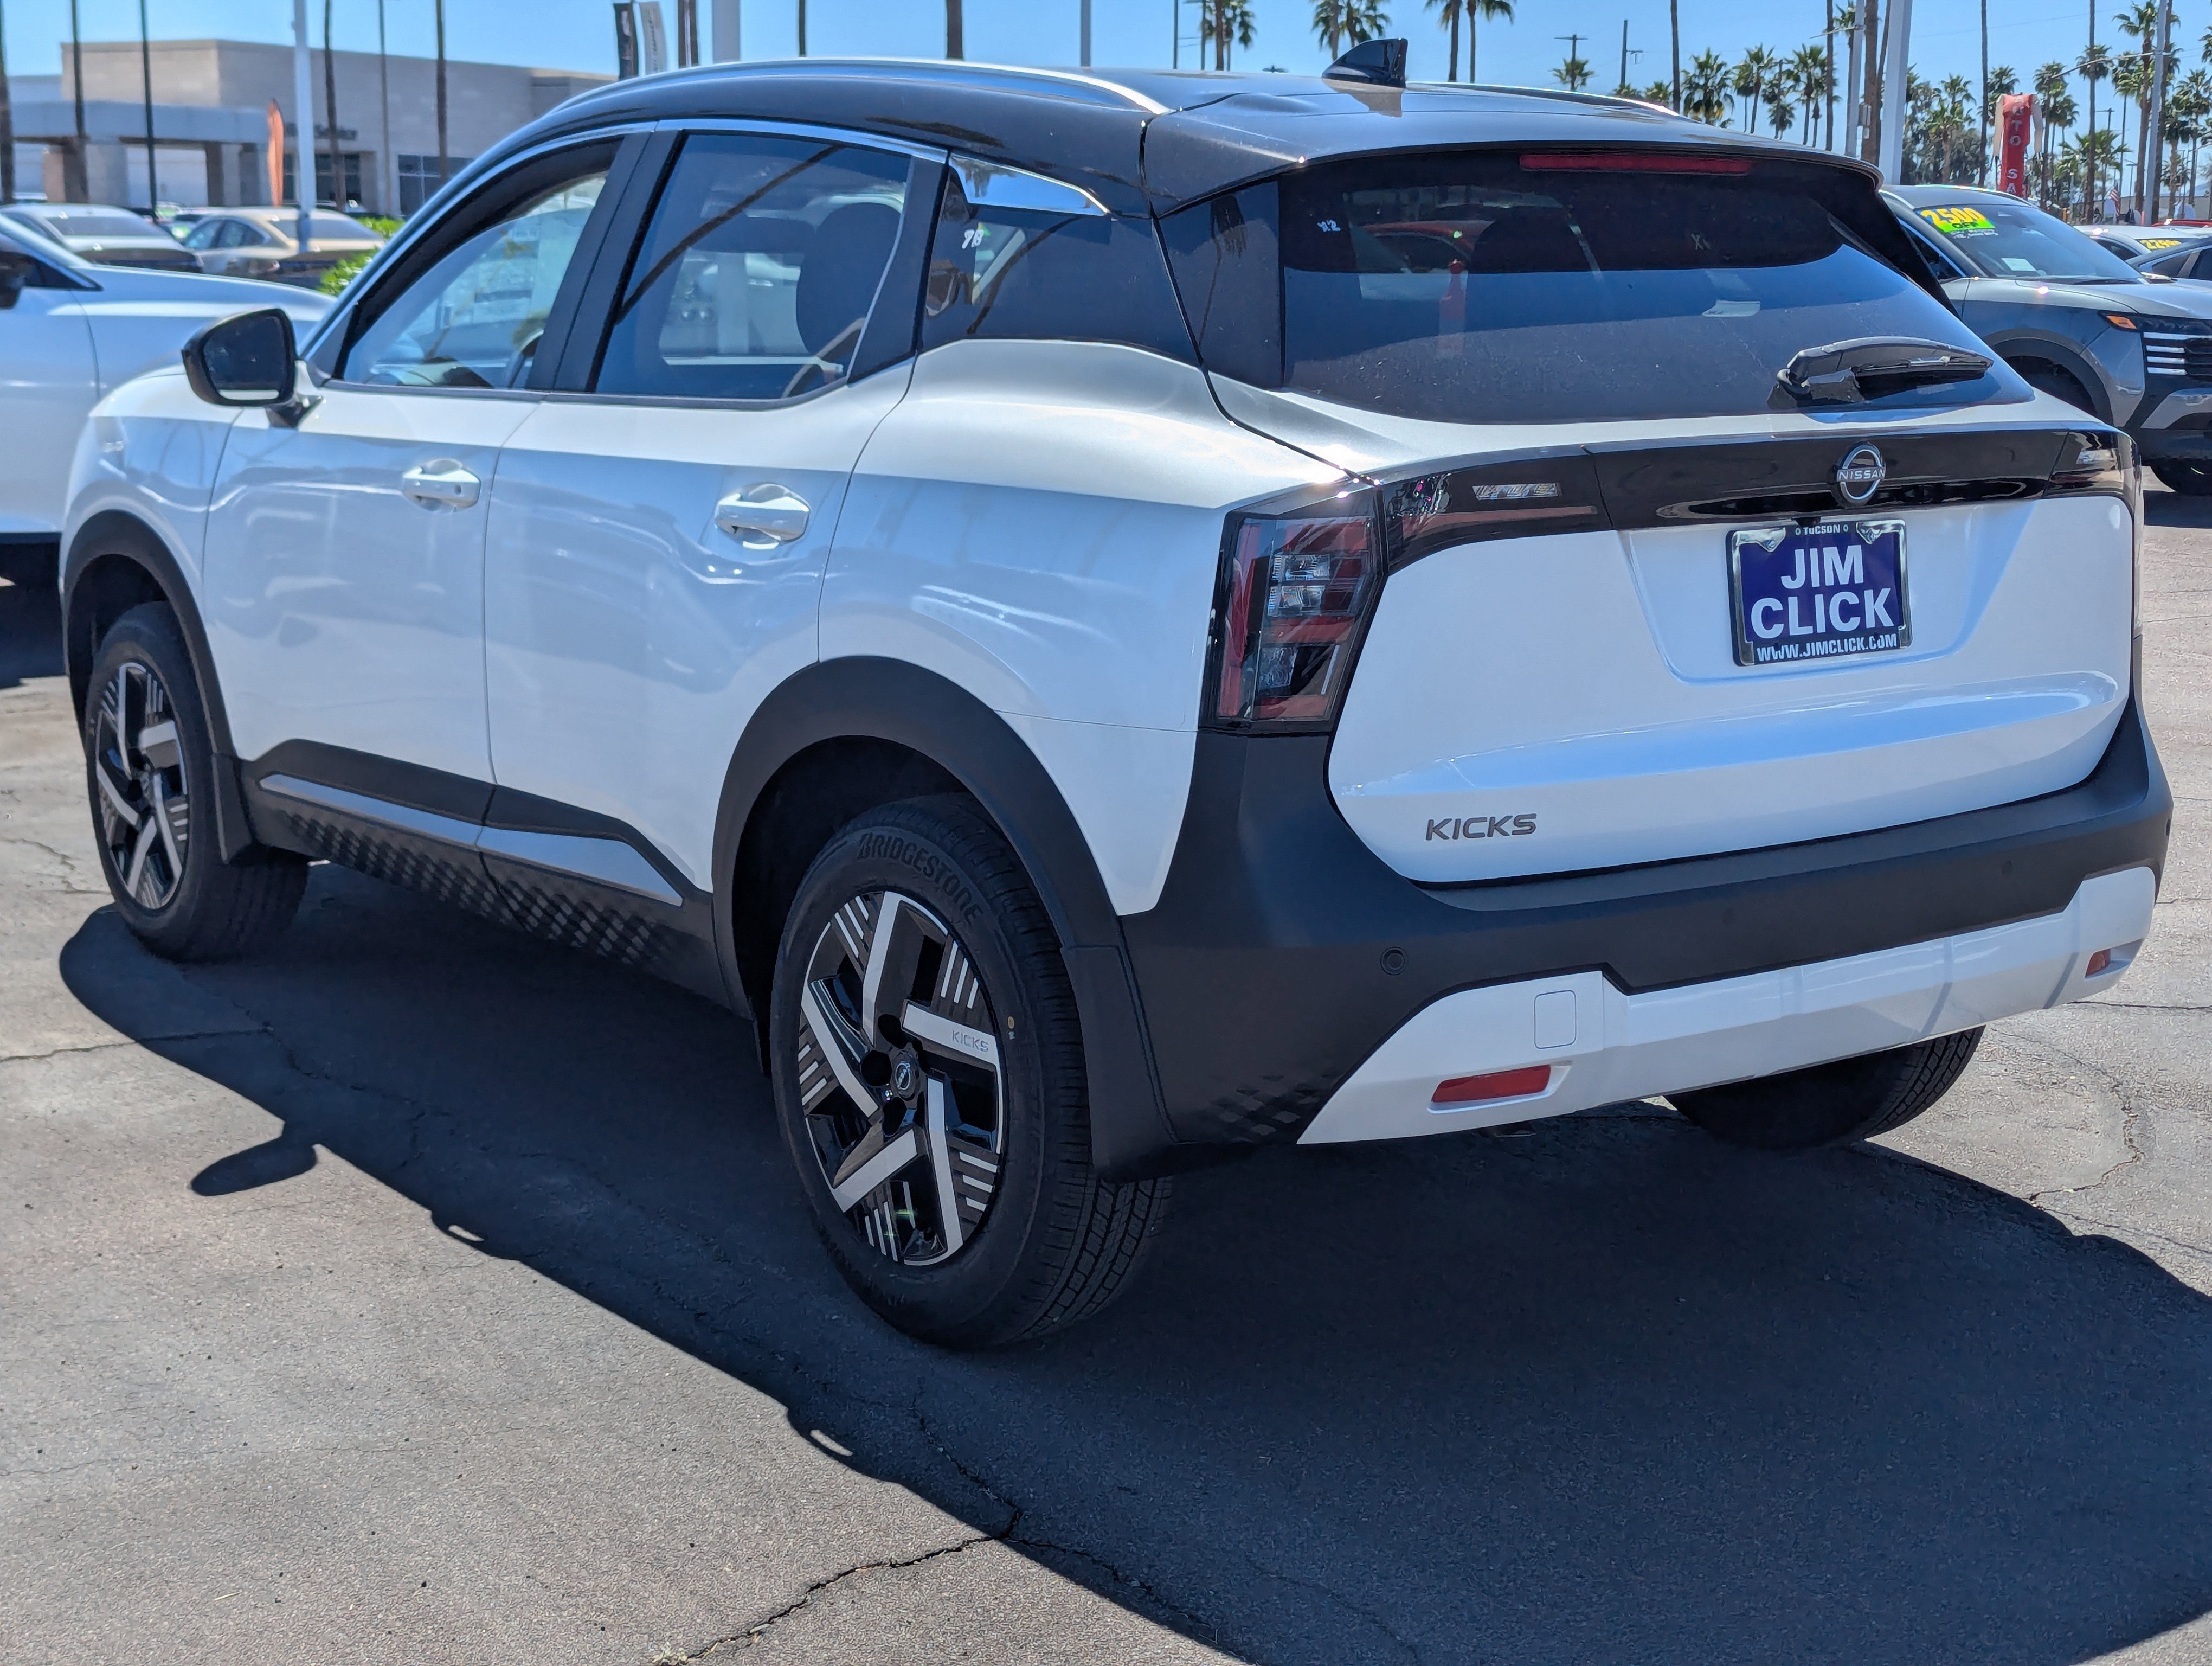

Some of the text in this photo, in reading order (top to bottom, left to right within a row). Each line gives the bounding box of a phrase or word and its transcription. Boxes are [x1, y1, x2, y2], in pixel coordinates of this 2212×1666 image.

[1920, 207, 1986, 227] 2500
[1838, 469, 1885, 480] NISSAN
[1803, 524, 1841, 535] TUCSON
[1780, 544, 1864, 589] JIM
[1751, 587, 1895, 639] CLICK
[1756, 633, 1897, 662] WWW.JIMCLICK.COM
[1425, 813, 1538, 841] KICKS
[856, 831, 984, 927] BRIDGESTONE
[951, 1029, 989, 1053] KICKS
